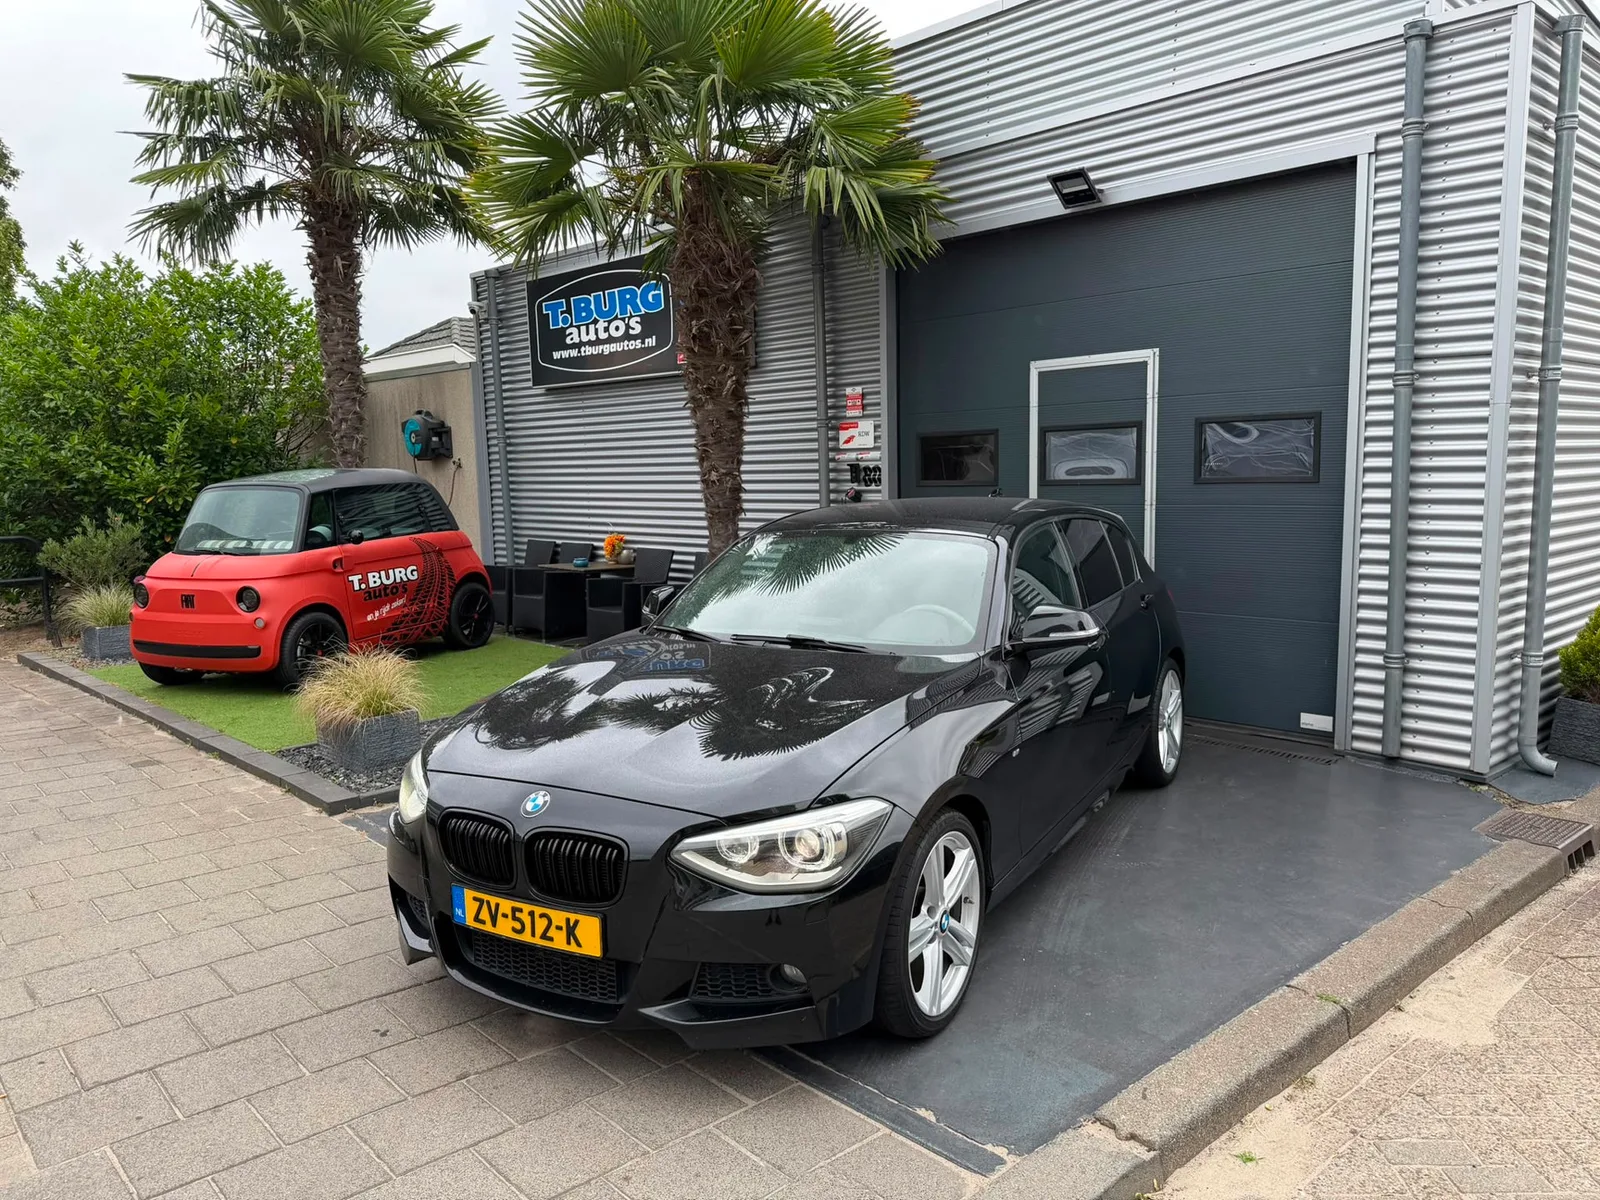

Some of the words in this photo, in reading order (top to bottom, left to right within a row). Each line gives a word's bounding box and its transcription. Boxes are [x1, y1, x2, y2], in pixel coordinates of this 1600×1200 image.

[566, 317, 642, 344] auto's
[553, 336, 656, 360] www.tburgautos.nl
[455, 907, 464, 918] NL
[472, 896, 583, 948] ZV-512-K
